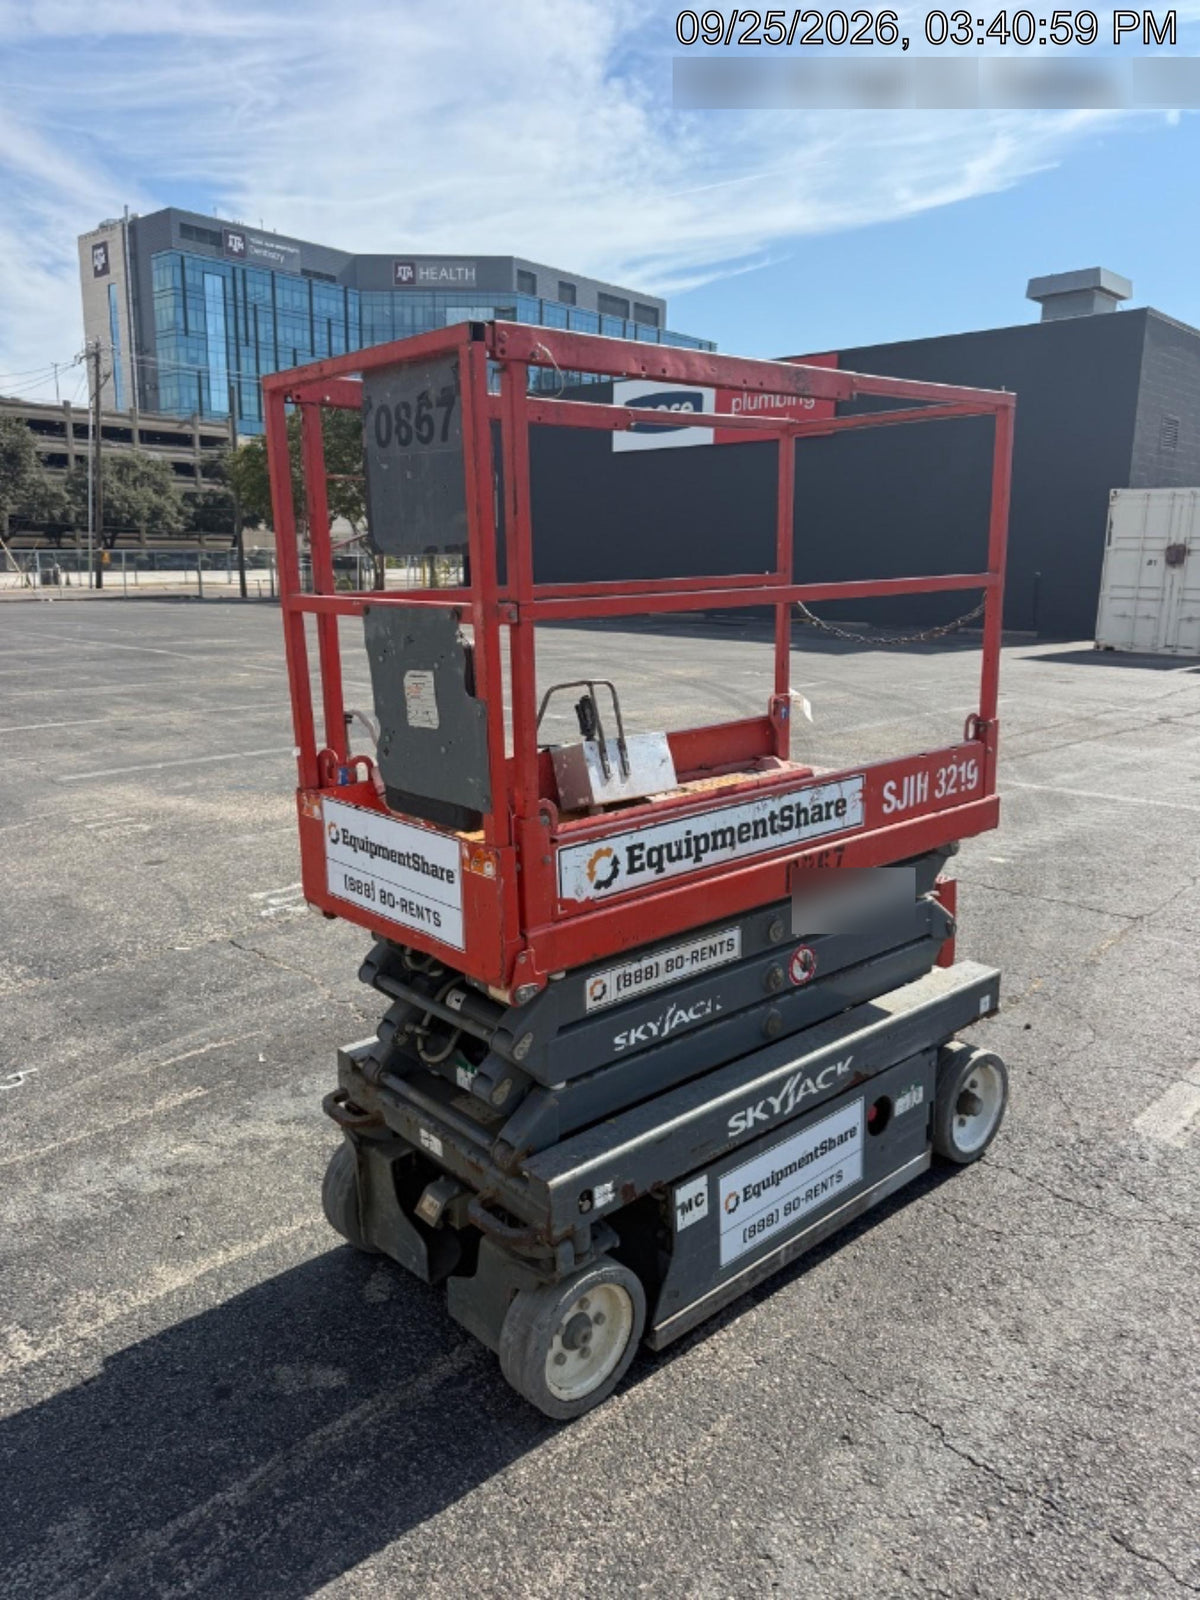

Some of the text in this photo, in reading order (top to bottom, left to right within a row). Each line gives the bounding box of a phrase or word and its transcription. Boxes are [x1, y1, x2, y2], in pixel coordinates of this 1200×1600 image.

[419, 267, 477, 281] HEALTH
[375, 385, 456, 449] 0867
[935, 759, 979, 799] 3219
[341, 827, 455, 885] EquipmentShare
[625, 797, 847, 876] EquipmentShare
[344, 874, 442, 928] (888) 80-RENTS
[616, 938, 735, 992] (888) 80-RENTS
[727, 1055, 854, 1137] SKYJACK
[742, 1125, 858, 1202] EquipmentShare
[743, 1169, 844, 1244] (888) 80-RENTS
